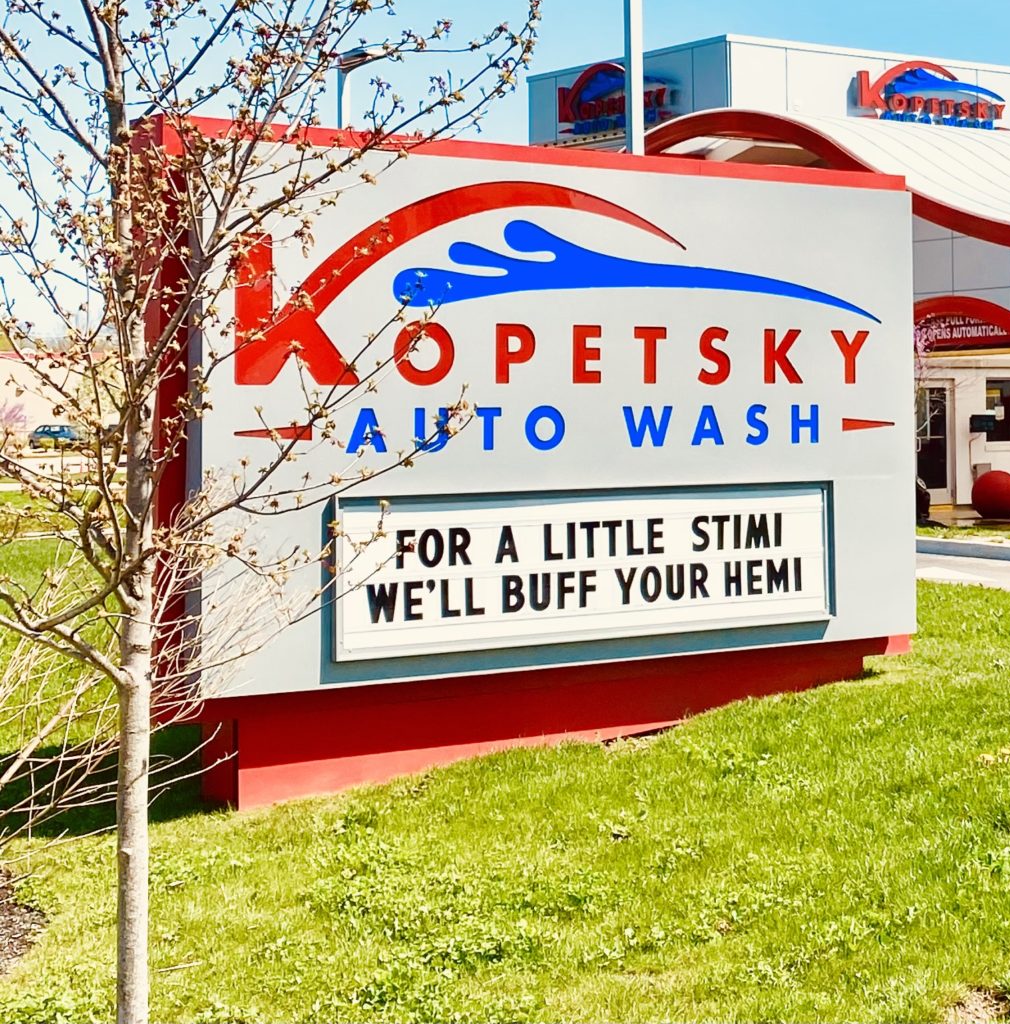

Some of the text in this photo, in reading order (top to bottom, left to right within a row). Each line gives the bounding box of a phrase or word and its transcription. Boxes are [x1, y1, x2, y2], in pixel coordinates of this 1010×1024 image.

[856, 61, 1006, 120] KOPETSKY
[234, 180, 869, 386] KOPETSKY
[346, 404, 820, 454] AUTO WASH
[395, 512, 783, 569] FOR A LITTLE STIMI
[366, 556, 802, 624] WE'LL BUFF YOUR HEMI
